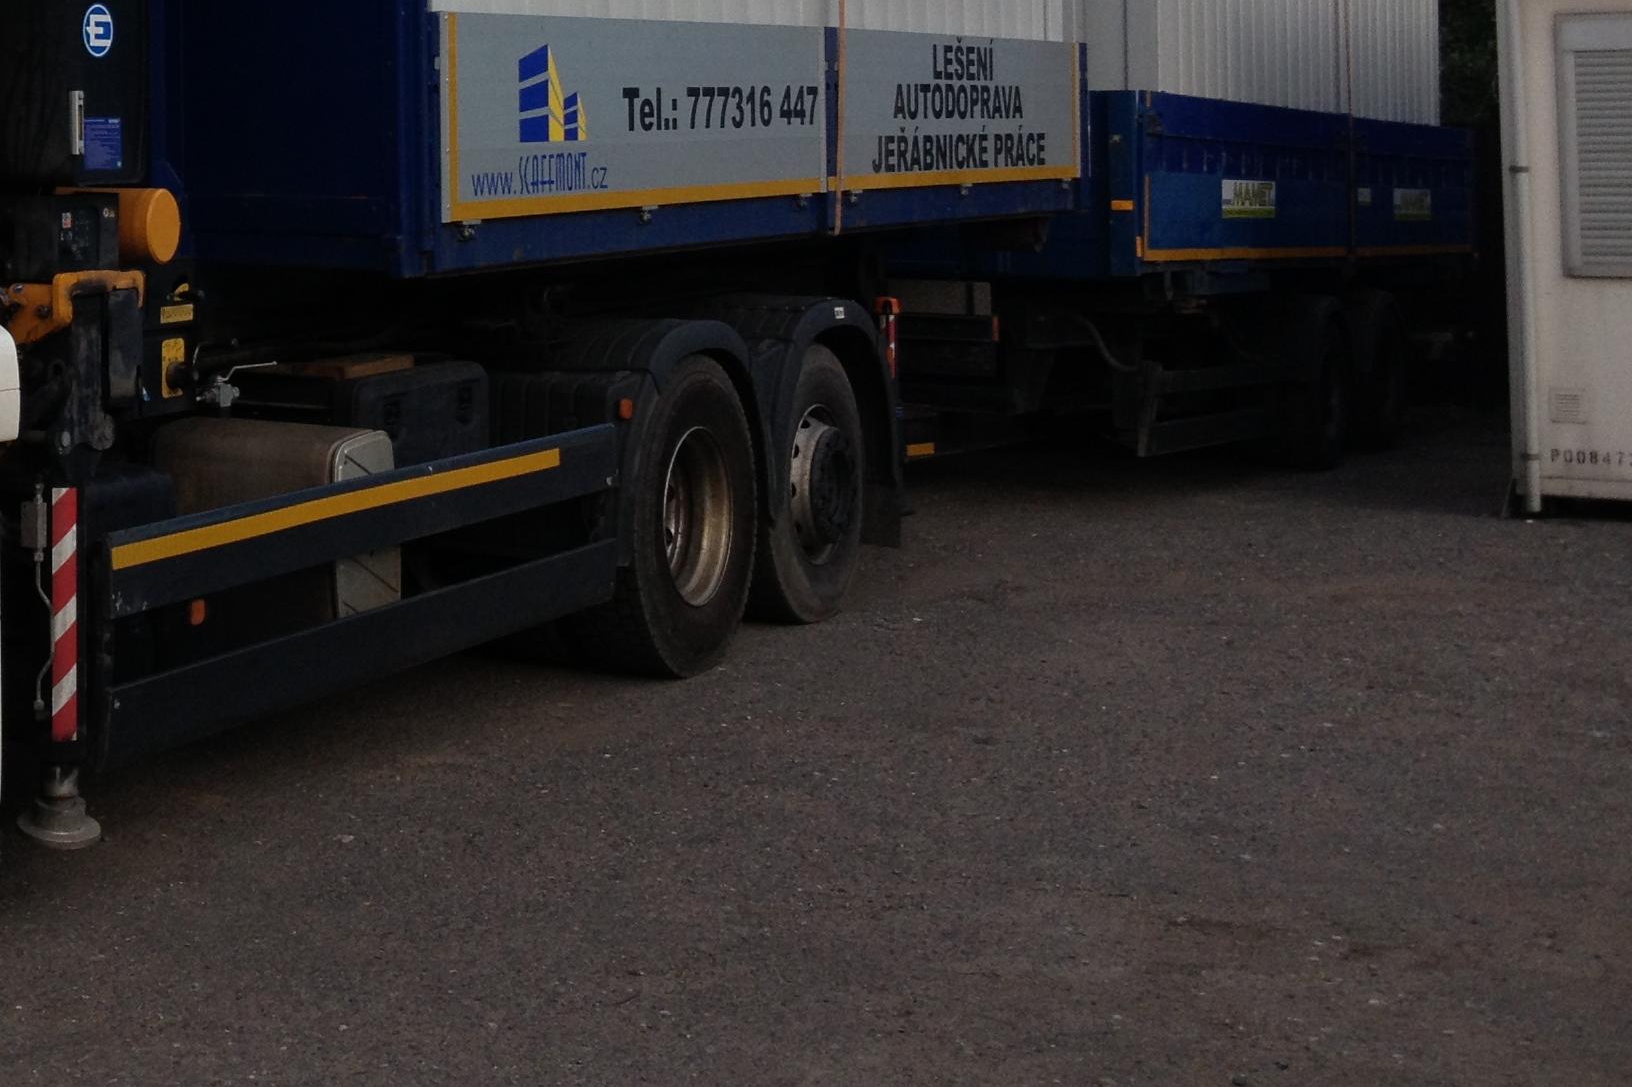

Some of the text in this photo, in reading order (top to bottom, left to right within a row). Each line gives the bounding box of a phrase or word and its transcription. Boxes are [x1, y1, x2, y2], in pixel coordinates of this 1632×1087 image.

[932, 36, 994, 81] LEŠENÍ
[623, 87, 678, 132] Tel.:
[779, 85, 819, 126] 447
[893, 83, 1024, 120] AUTODOPRAVA
[872, 124, 1046, 174] JEŘÁBNICKÉ PRÁCE
